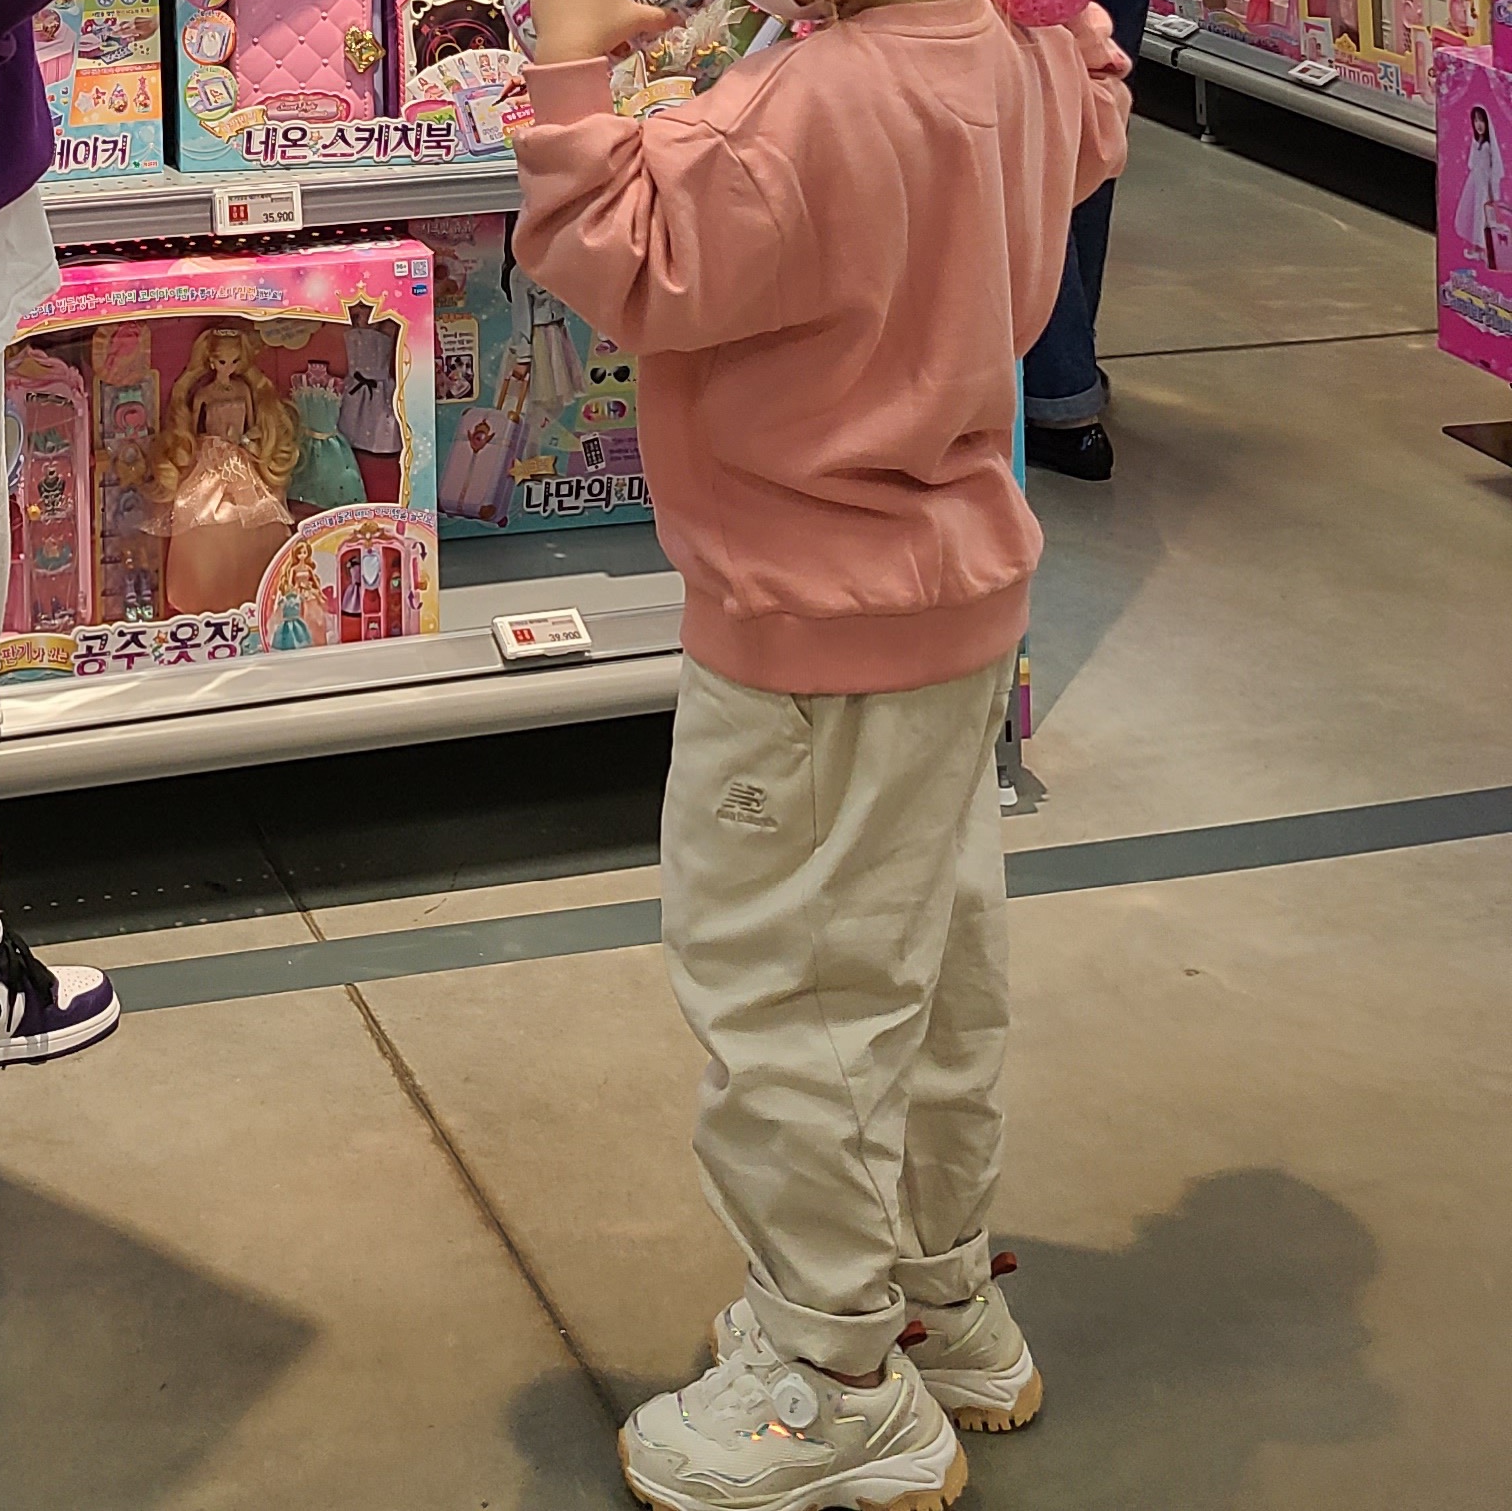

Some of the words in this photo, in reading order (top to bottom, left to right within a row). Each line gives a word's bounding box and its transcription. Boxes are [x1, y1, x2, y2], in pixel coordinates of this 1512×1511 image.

[245, 124, 309, 164] 네온
[321, 122, 457, 162] 스케치북
[262, 211, 294, 223] 35,900
[525, 477, 612, 514] 나만의
[73, 630, 151, 677] 공주
[164, 617, 245, 666] 옷장
